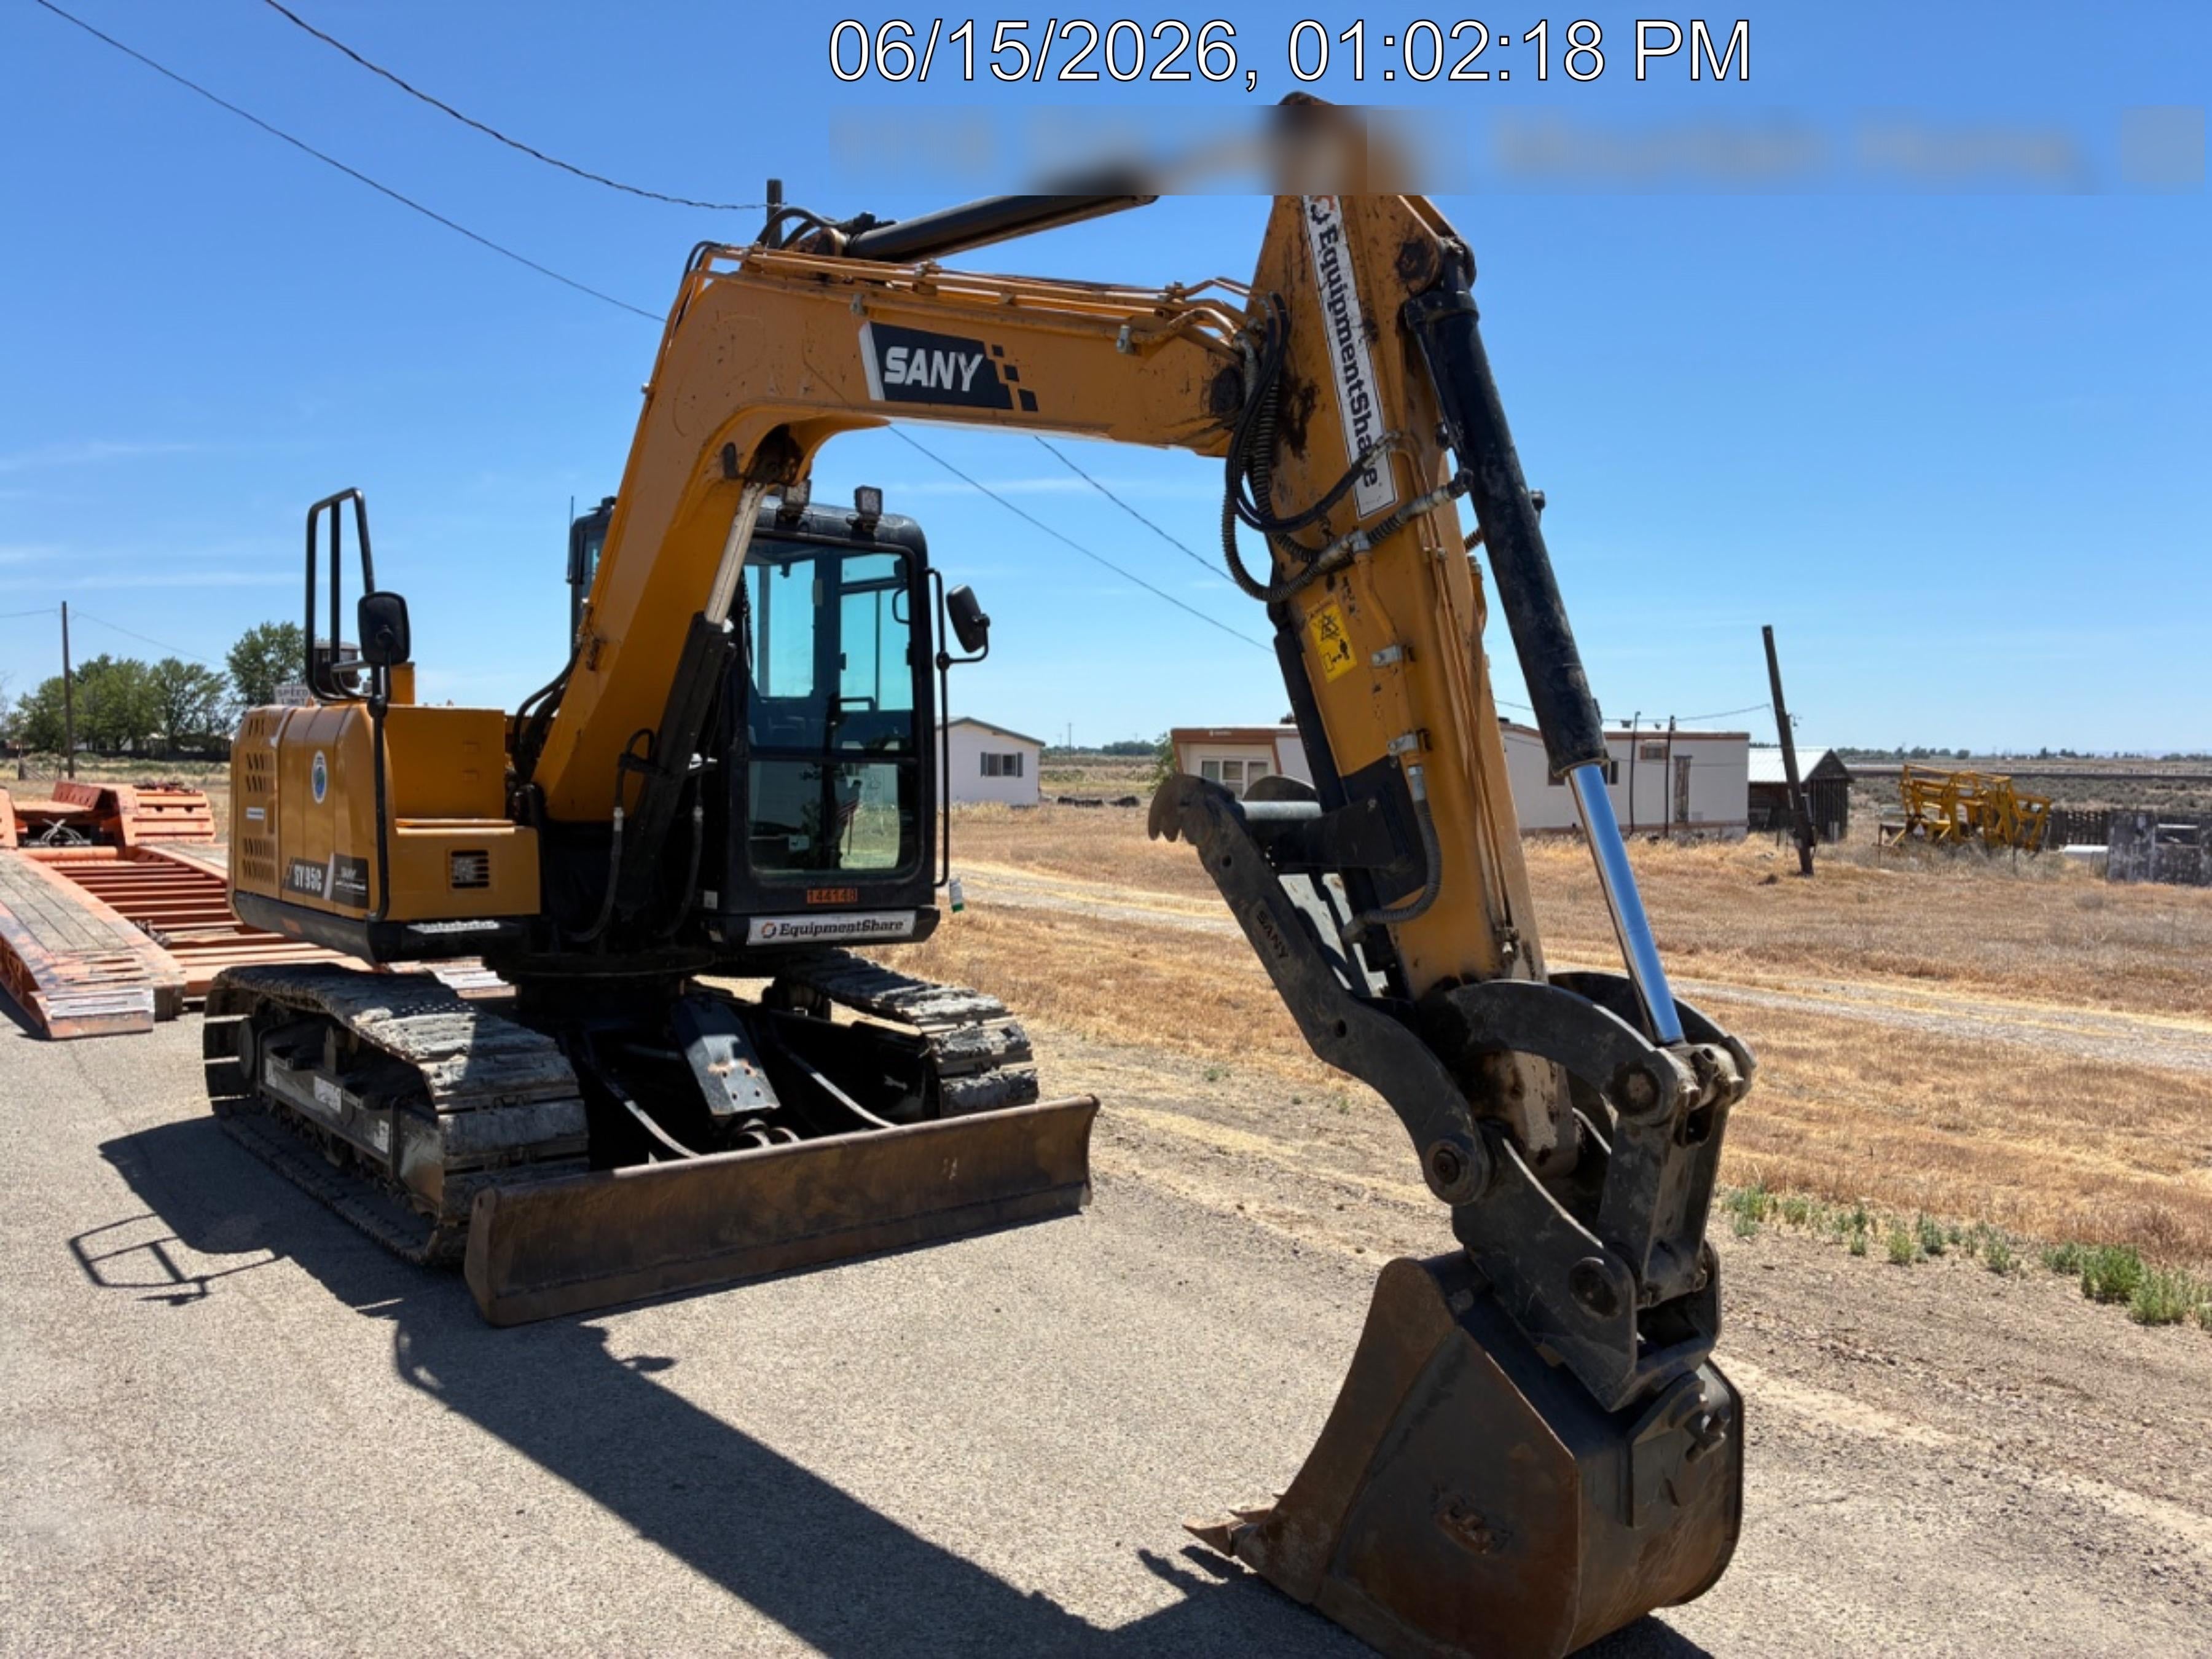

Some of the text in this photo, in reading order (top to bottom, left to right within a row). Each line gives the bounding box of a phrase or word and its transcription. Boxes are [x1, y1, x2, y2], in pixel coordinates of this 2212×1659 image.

[884, 346, 984, 392] SANY
[1318, 224, 1378, 488] EquipmentShae
[278, 688, 308, 697] SPEED
[779, 919, 904, 938] EquipmentShare
[1257, 910, 1289, 959] SANY
